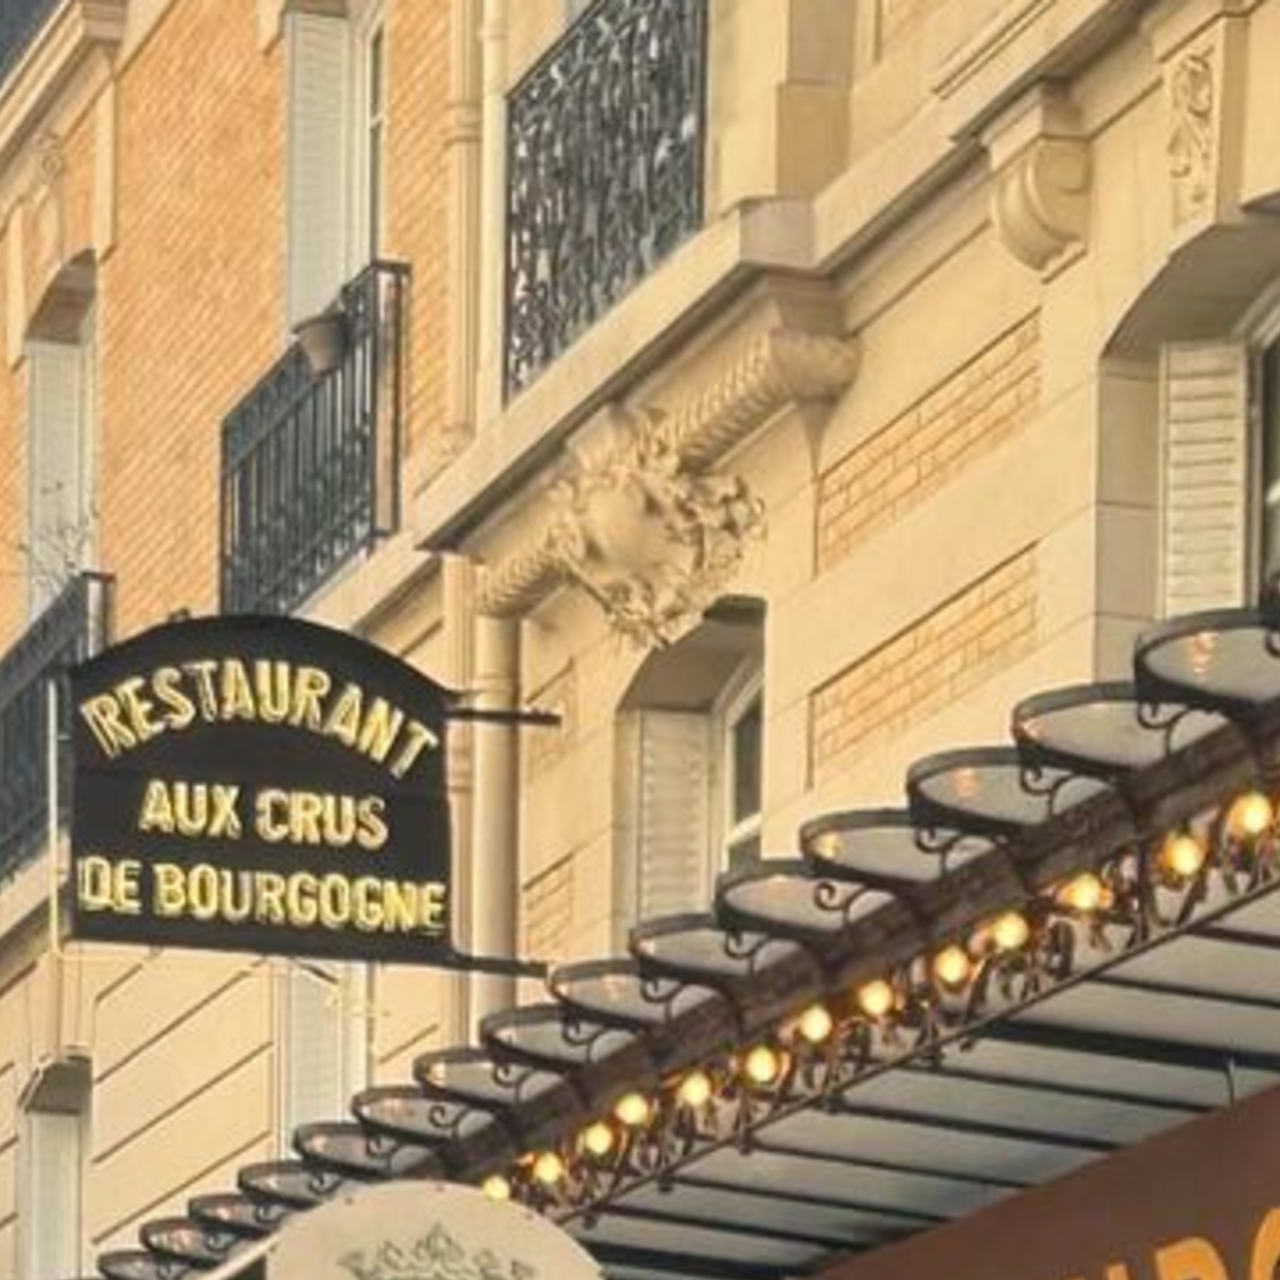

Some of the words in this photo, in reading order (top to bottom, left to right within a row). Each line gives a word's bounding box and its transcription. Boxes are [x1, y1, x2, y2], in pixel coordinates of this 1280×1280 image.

[79, 658, 440, 780] RESTAURANT
[139, 779, 241, 837] AUX
[255, 788, 389, 850] CRUS
[77, 855, 142, 915] DE
[153, 863, 446, 933] BOURGOGNE
